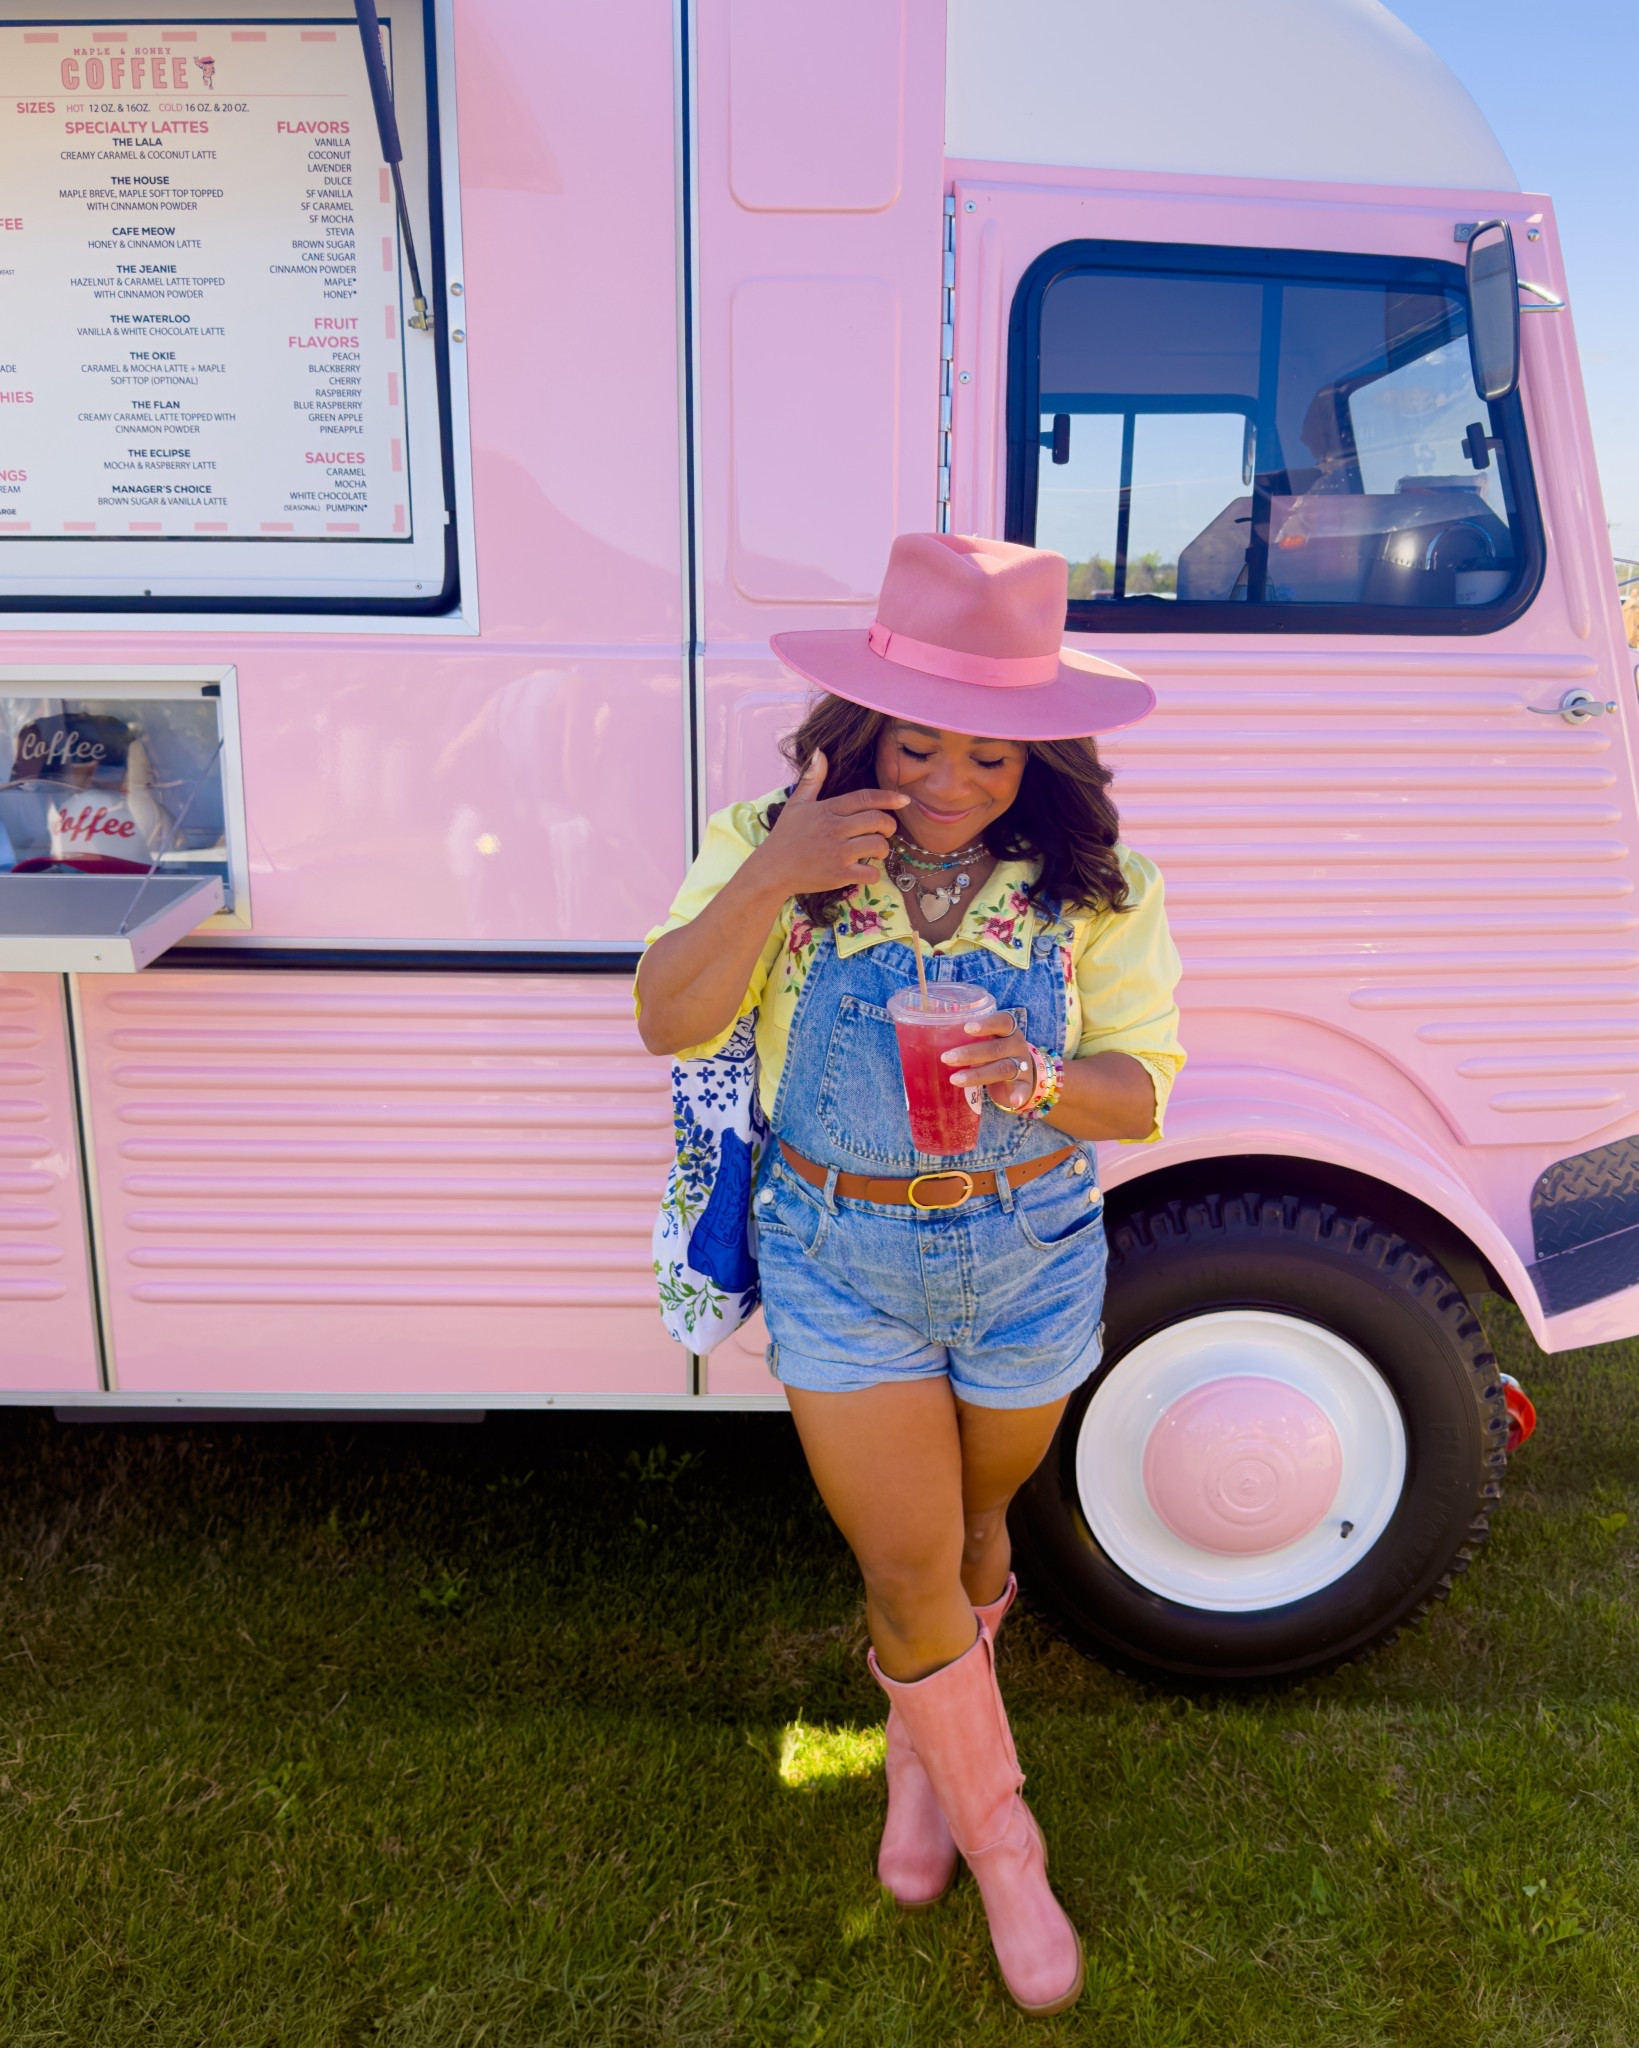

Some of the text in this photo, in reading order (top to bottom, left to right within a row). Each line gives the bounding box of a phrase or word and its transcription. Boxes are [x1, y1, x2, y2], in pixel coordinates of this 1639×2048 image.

[73, 47, 110, 56] MAPLE
[134, 47, 171, 56] HONEY
[60, 57, 188, 90] COFFEE
[16, 102, 56, 114] SIZES
[67, 103, 250, 113] HOT 12 OZ. & 16OZ. COLD 16 OZ. & 20 OZ.
[65, 121, 209, 134] SPECIALTY LATTES
[277, 121, 350, 134] FLAVORS
[112, 138, 163, 146] THE LALA
[314, 138, 351, 147] VANILLA
[60, 150, 217, 160] CREAMY CARAMEL & COCONUT LATTE
[308, 151, 351, 160] COCONUT
[307, 163, 352, 173] LAVENDER
[110, 176, 169, 185] THE HOUSE
[324, 176, 352, 186] DULCE
[59, 189, 224, 198] MAPLE BREVE, MAPLE SOFT TOP TOPPED
[306, 189, 353, 198] SF VANILLA
[86, 201, 198, 211] WITH CINNAMON POWDER
[301, 202, 354, 211] SF CARAMEL
[309, 215, 354, 223] SF MOCHA
[112, 227, 175, 236] CAFE MEOW
[326, 227, 355, 236] STEVIA
[88, 239, 201, 249] HONEY & CINNAMON LATTE
[292, 240, 355, 249] BROWN SUGAR
[301, 252, 356, 261] CANE SUGAR
[116, 265, 177, 273] THE JEANIE
[269, 265, 357, 274] CINNAMON POWDER
[70, 277, 225, 286] HAZELNUT & CARAMEL LATTE TOPPED
[93, 290, 204, 299] WITH CINNAMON POWDER
[110, 314, 190, 323] THE WATERLOO
[314, 317, 359, 330] FRUIT
[77, 327, 225, 336] VANILLA & WHITE CHOCOLATE LATTE
[288, 336, 359, 348] FLAVORS
[129, 352, 176, 360] THE OKIE
[332, 352, 360, 361] PEACH
[81, 364, 121, 373] CARAMEL
[122, 364, 129, 373] &
[130, 364, 163, 372] MOCHA
[164, 364, 188, 373] LATTE
[198, 364, 226, 373] MAPLE
[309, 364, 361, 373] BLACKBERRY
[110, 376, 198, 385] SOFT TOP (OPTIONAL)
[329, 377, 361, 385] CHERRY
[315, 389, 362, 397] RASPBERRY
[131, 401, 180, 409] THE FLAN
[293, 401, 363, 410] BLUE RASPBERRY
[78, 413, 236, 422] CREAMY CARAMEL LATTE TOPPED WITH
[308, 413, 363, 422] GREEN APPLE
[115, 425, 200, 434] CINNAMON POWDER
[320, 425, 363, 434] PINEAPPLE
[128, 449, 191, 458] THE ECLIPSE
[305, 452, 365, 464] SAUCES
[104, 461, 216, 470] MOCHA & RASPBERRY LATTE
[326, 468, 366, 476] CARAMEL
[335, 480, 367, 488] MOCHA
[112, 485, 212, 494] MANAGER'S CHOICE
[289, 491, 367, 501] WHITE CHOCOLATE
[98, 497, 228, 506] BROWN SUGAR & VANILLA LATTE
[22, 730, 107, 765] Coffee
